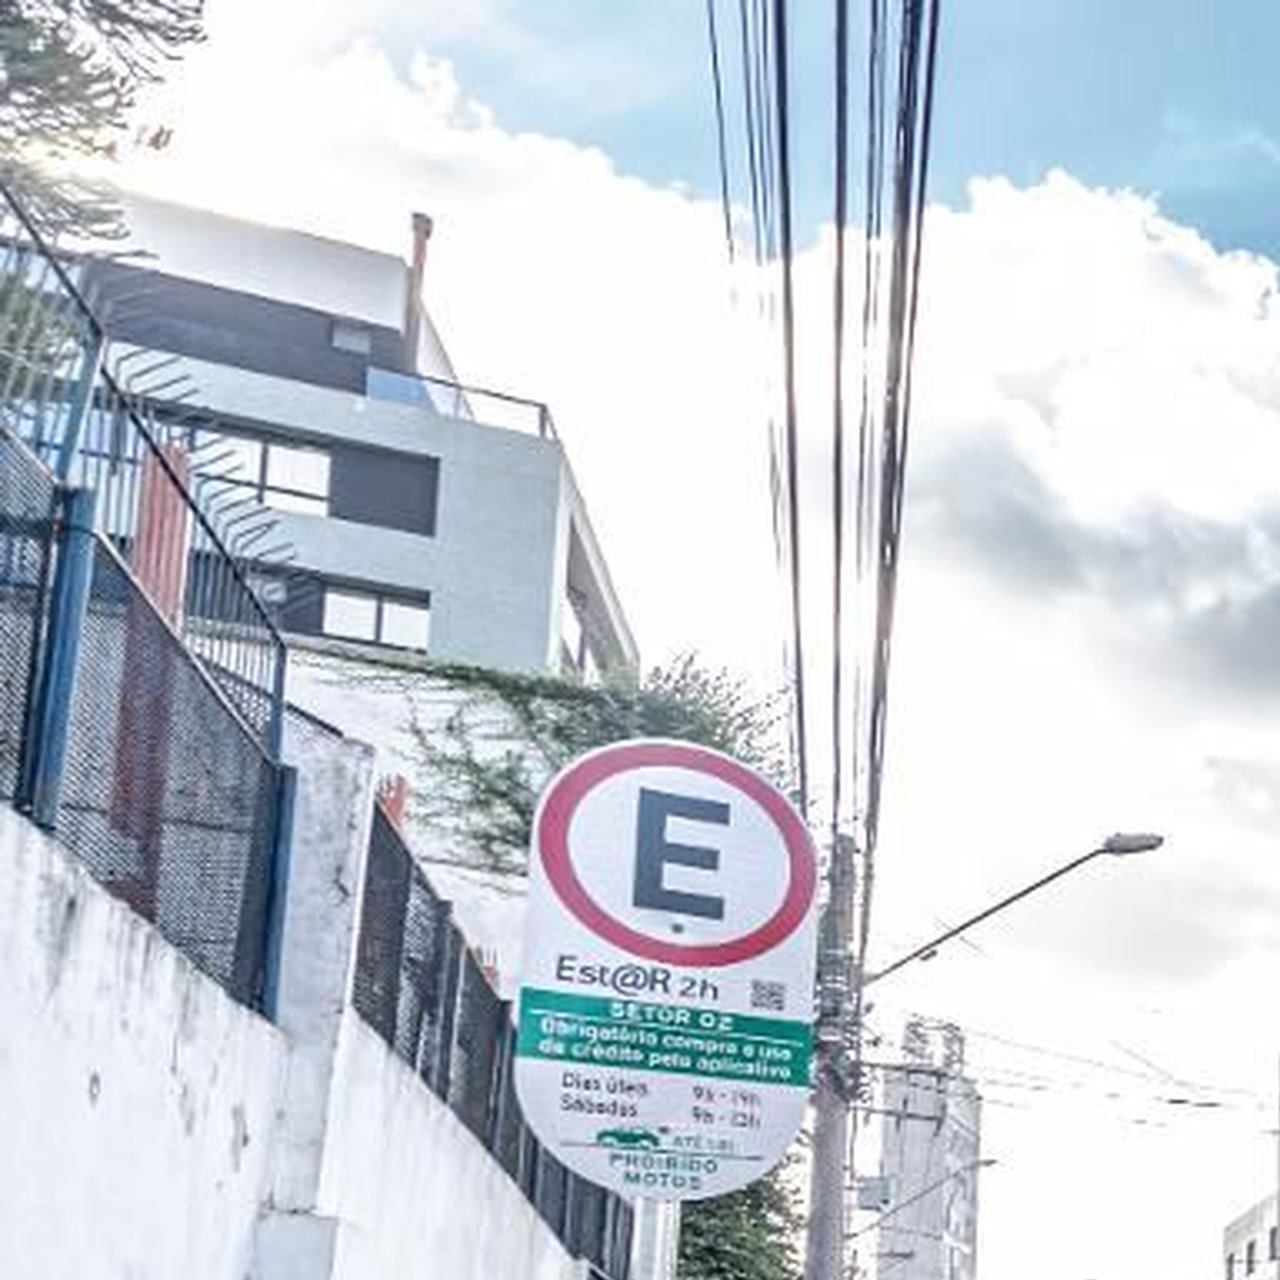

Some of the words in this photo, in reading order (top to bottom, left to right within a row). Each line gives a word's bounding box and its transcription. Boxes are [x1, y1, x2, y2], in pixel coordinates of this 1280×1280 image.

[633, 787, 730, 920] E
[556, 955, 672, 997] Est@R
[680, 976, 718, 1000] 2h
[611, 1002, 691, 1024] SETOR
[541, 1017, 658, 1047] Obrigatório
[662, 1035, 738, 1055] compra
[742, 1044, 755, 1058] e
[759, 1045, 792, 1060] uso
[539, 1037, 565, 1055] de
[571, 1040, 645, 1060] crédito
[696, 1054, 792, 1078] aplicativo
[562, 1072, 601, 1090] Dias
[561, 1093, 637, 1117] Sábados
[609, 1153, 717, 1174] PROIBIDO
[623, 1172, 700, 1191] MOTOS
